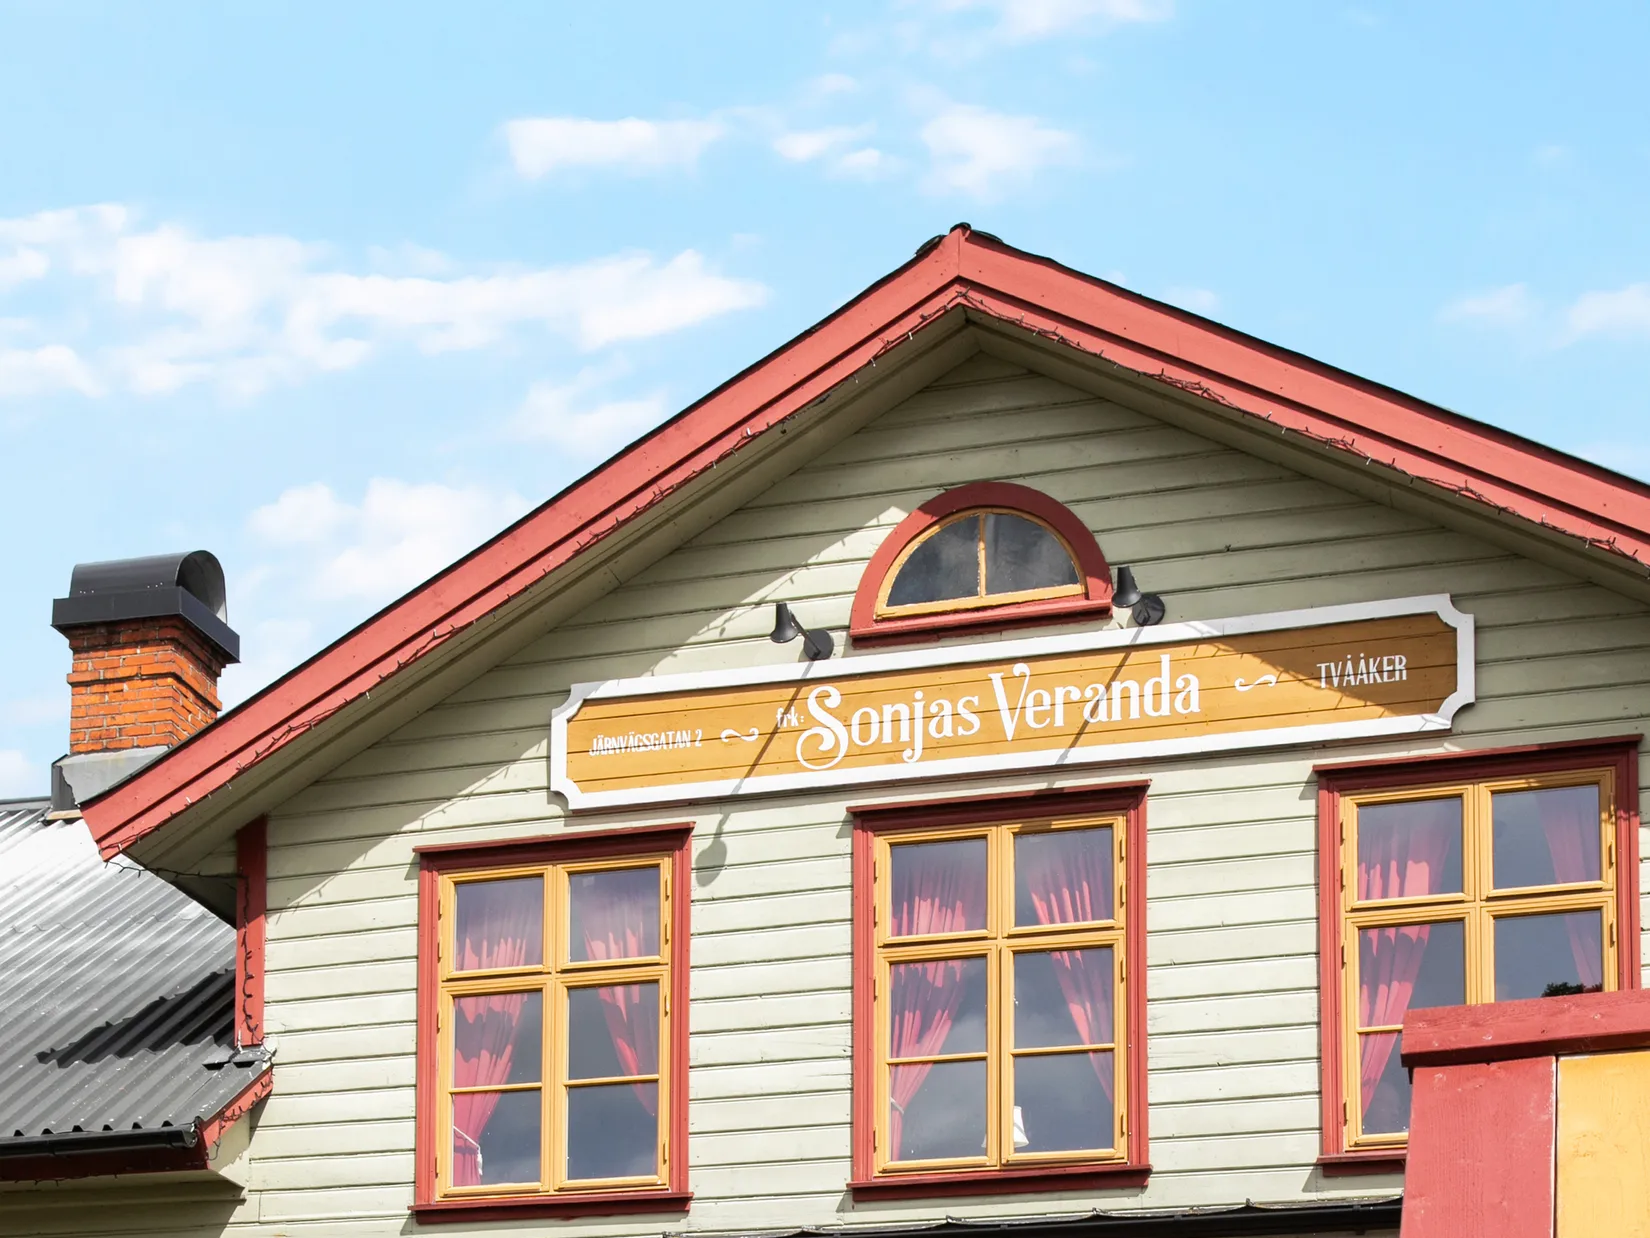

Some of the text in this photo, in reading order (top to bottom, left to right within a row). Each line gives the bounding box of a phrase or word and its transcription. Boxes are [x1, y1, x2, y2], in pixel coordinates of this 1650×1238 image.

[1316, 652, 1408, 689] TVÅÅKER
[776, 653, 1201, 770] frk: Sonjas Veranda
[589, 728, 703, 756] JÄRNVÄGSGATAN 2
